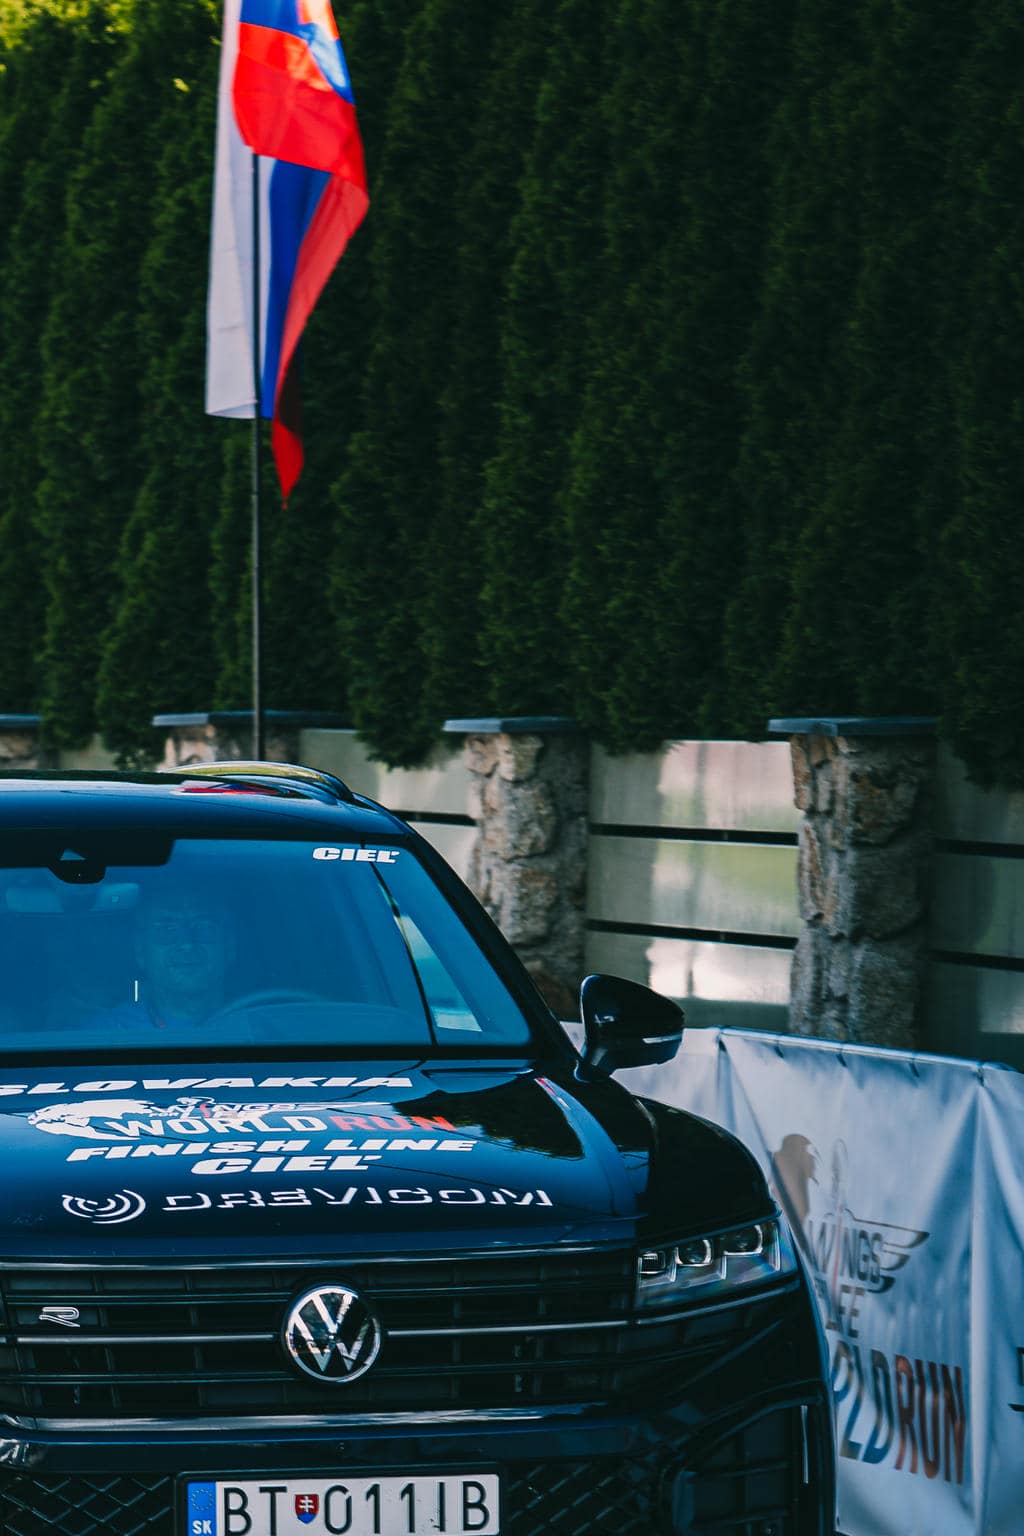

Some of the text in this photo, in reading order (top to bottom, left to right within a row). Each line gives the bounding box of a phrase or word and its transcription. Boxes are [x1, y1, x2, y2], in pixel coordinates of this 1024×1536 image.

[66, 1139, 477, 1161] FINISH LINE
[223, 1486, 288, 1536] BT
[192, 1520, 213, 1534] SK
